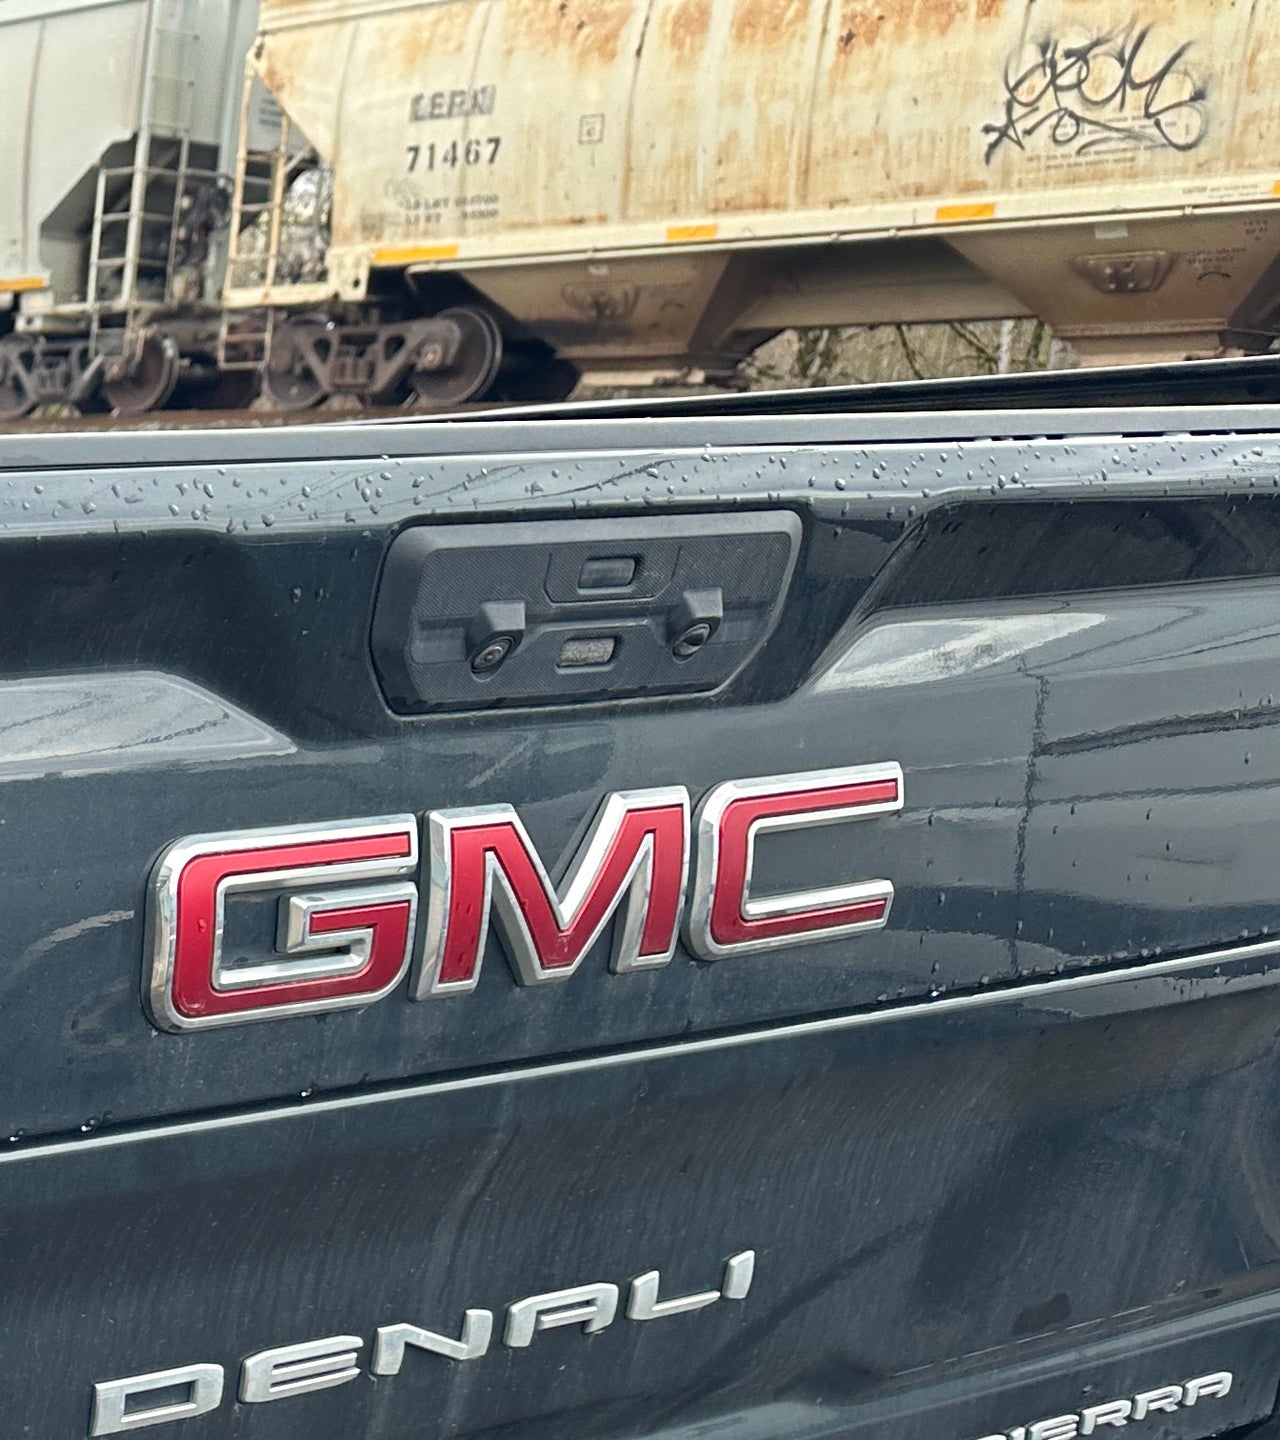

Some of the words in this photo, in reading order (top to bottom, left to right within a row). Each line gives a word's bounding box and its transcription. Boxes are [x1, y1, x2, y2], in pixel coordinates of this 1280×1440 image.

[406, 137, 501, 172] 71467
[142, 760, 904, 1035] GMC
[90, 1250, 754, 1436] DENALI
